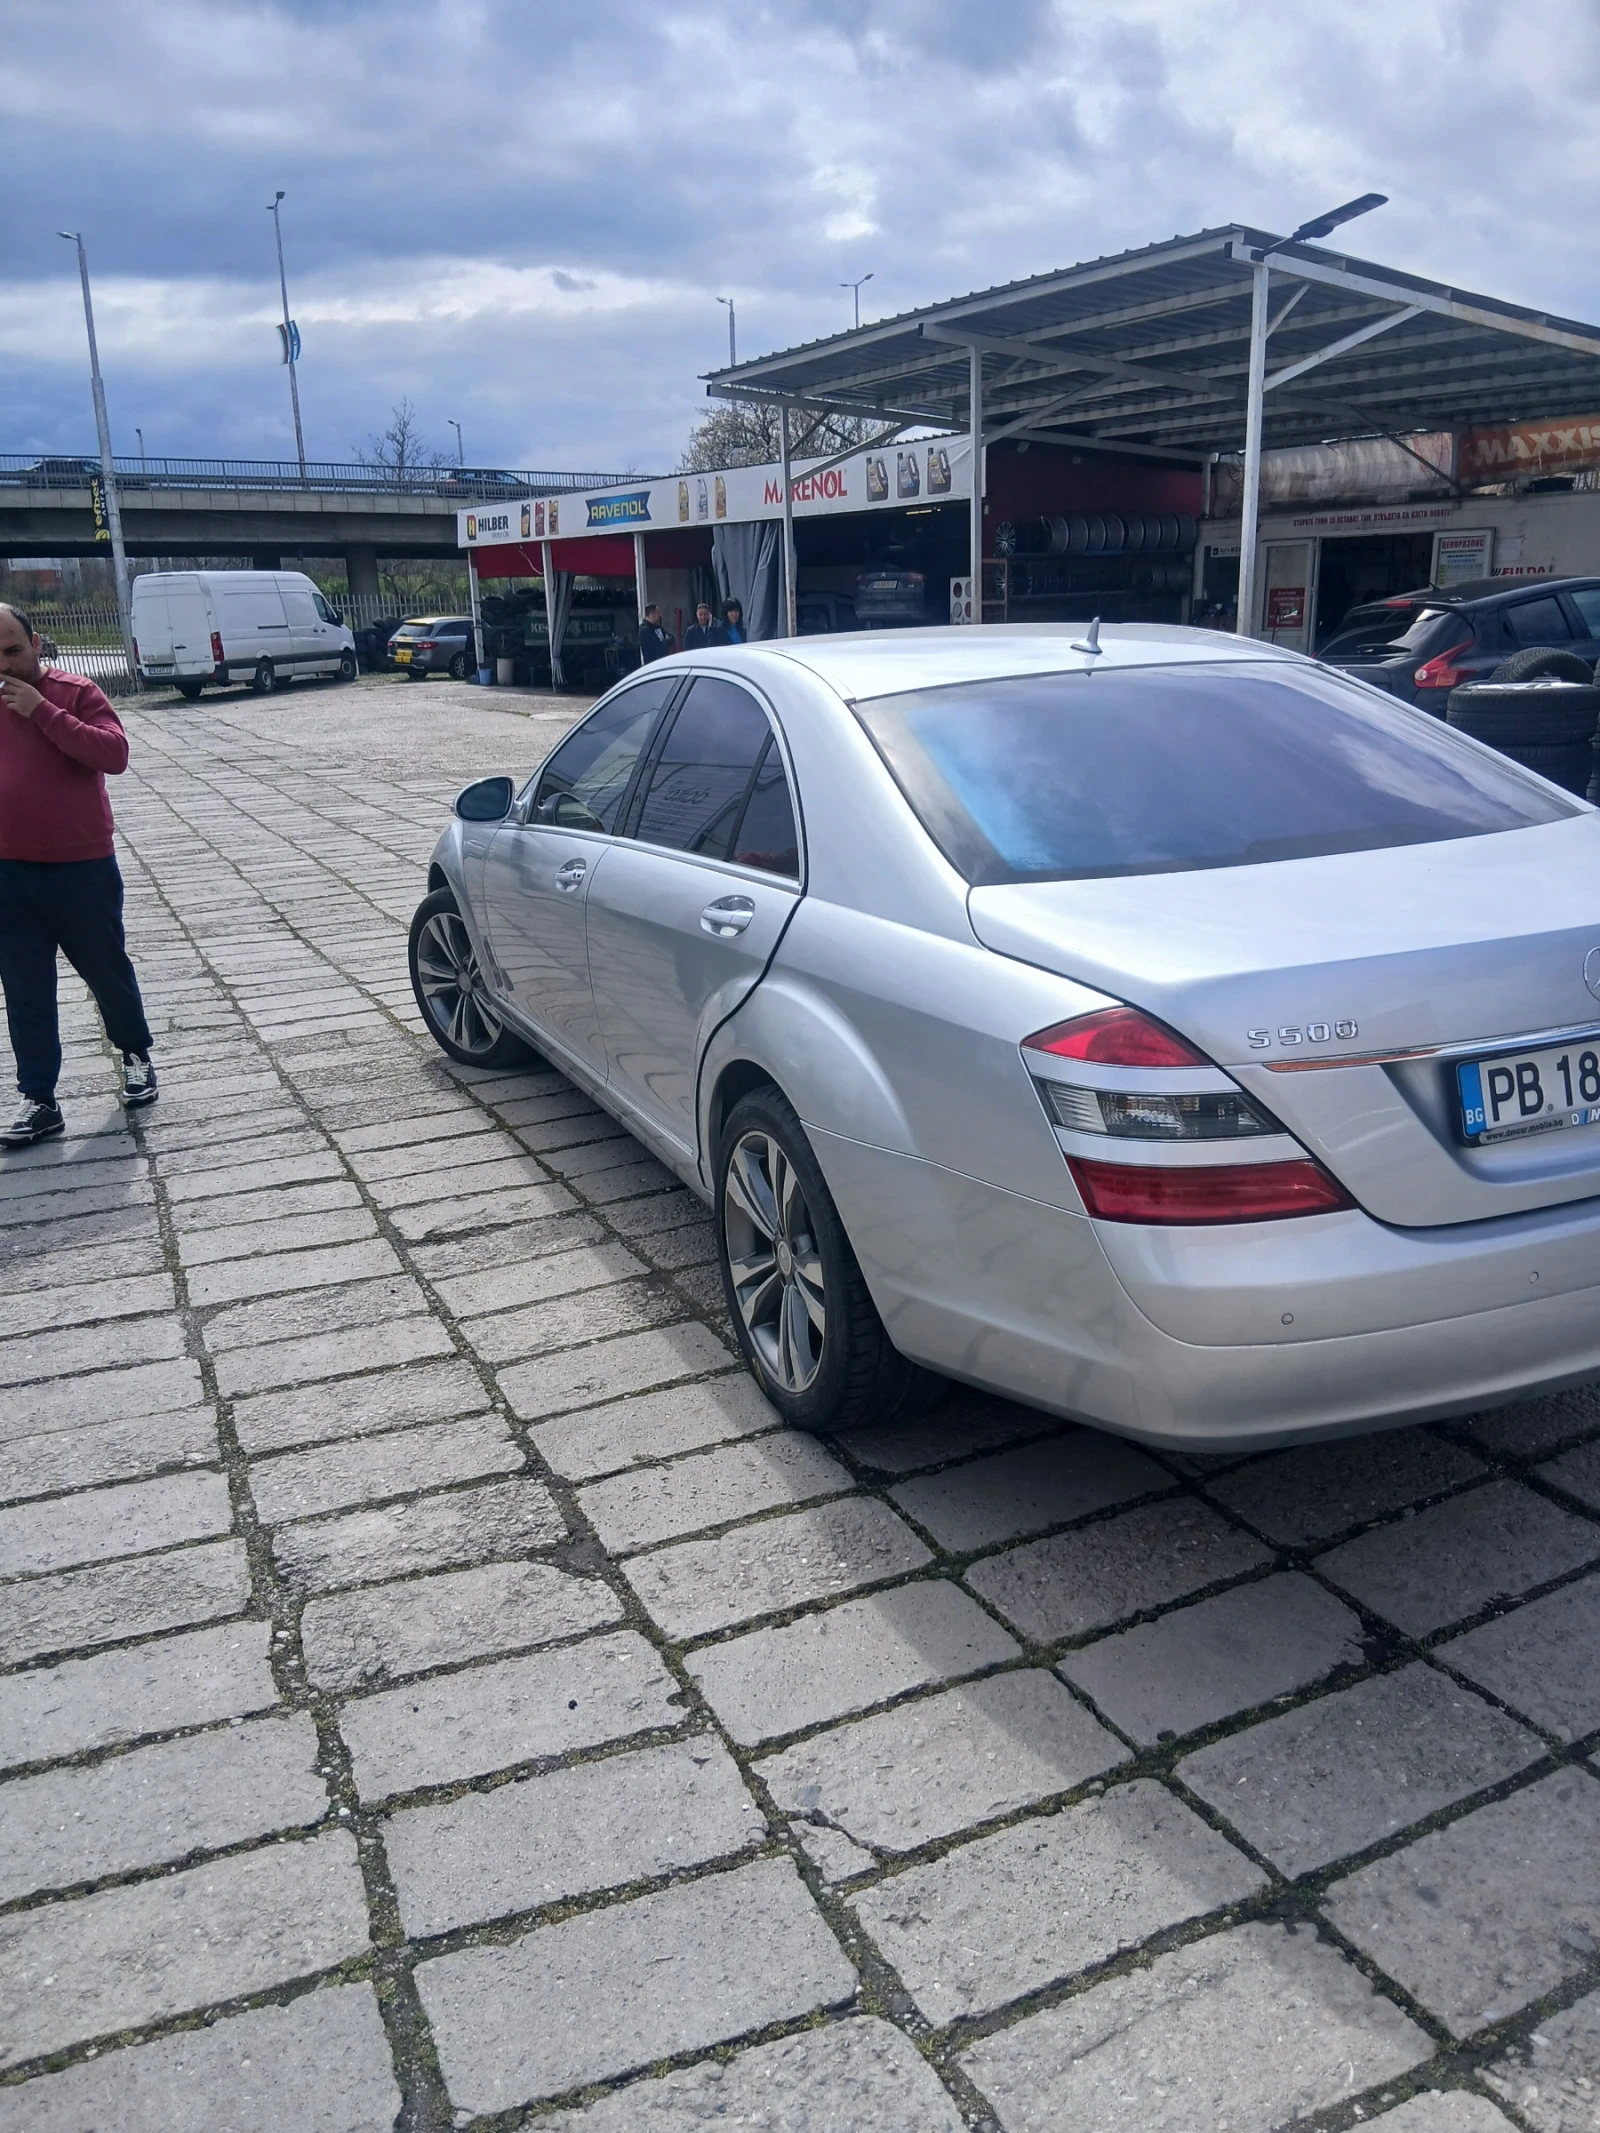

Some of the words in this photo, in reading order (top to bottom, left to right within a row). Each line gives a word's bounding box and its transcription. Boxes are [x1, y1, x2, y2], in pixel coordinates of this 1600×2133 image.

[92, 478, 103, 527] efbet
[591, 501, 645, 520] RAVENOL
[478, 515, 509, 532] HILBER
[1402, 511, 1409, 519] СА
[583, 621, 610, 632] TIRES
[1487, 1062, 1544, 1122] PB
[1556, 1051, 1600, 1107] 18
[1466, 1108, 1484, 1125] BG
[1485, 1119, 1564, 1141] www.dmcar.mobile.bg
